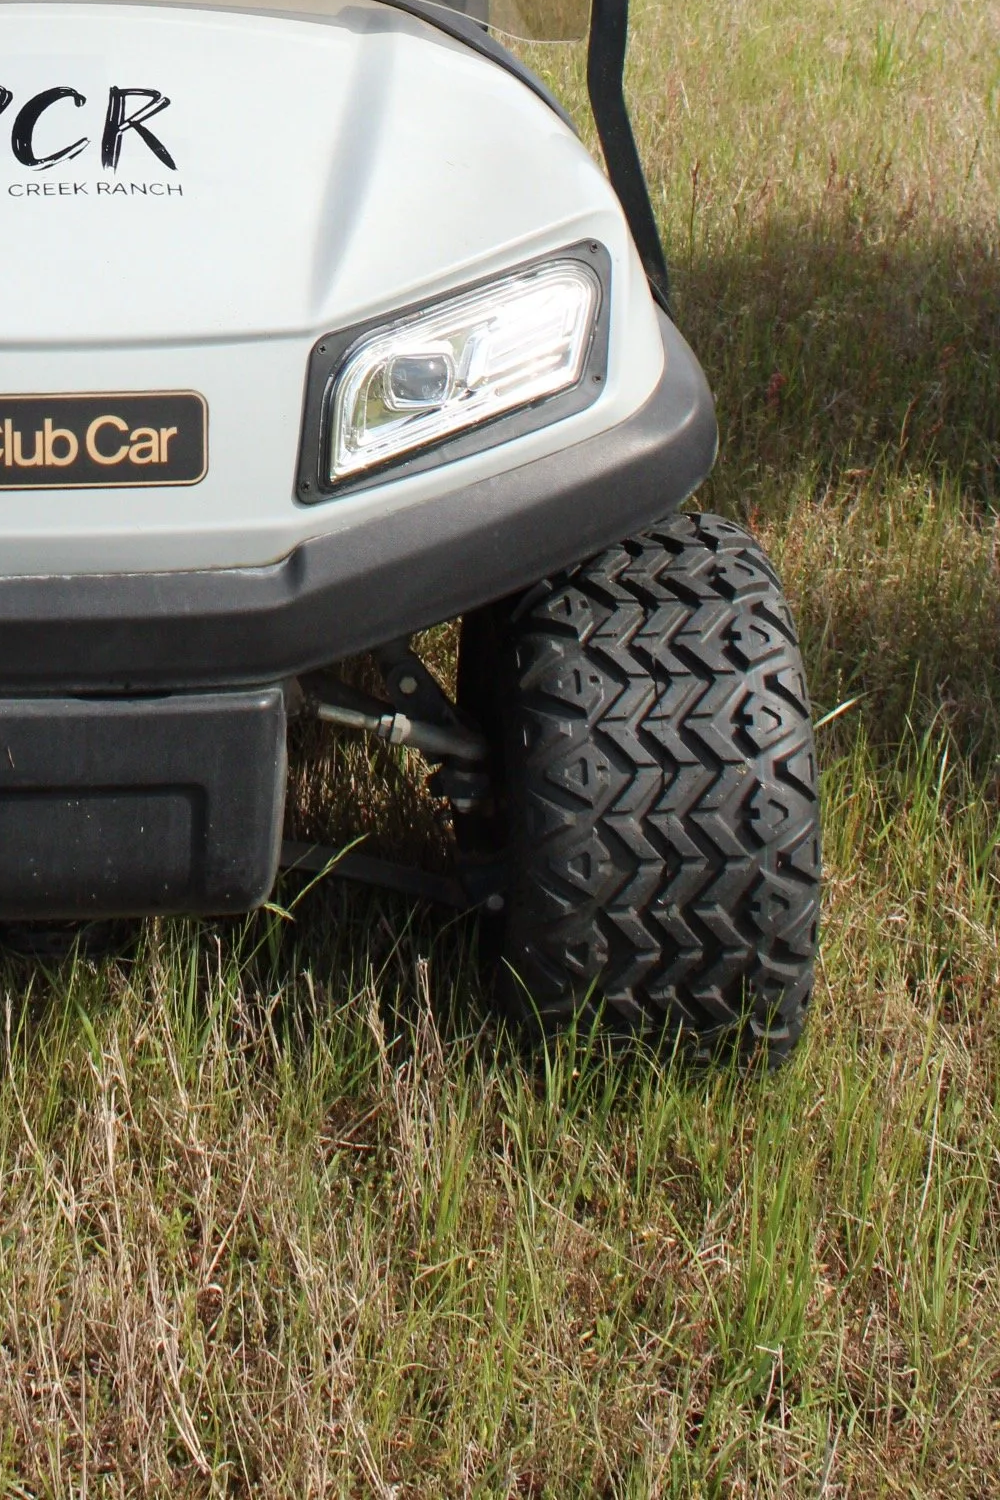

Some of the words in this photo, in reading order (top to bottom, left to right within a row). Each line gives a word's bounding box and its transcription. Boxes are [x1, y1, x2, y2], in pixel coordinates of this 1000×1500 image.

[8, 182, 88, 197] CREEK
[96, 182, 183, 197] RANCH
[86, 415, 178, 465] Car
